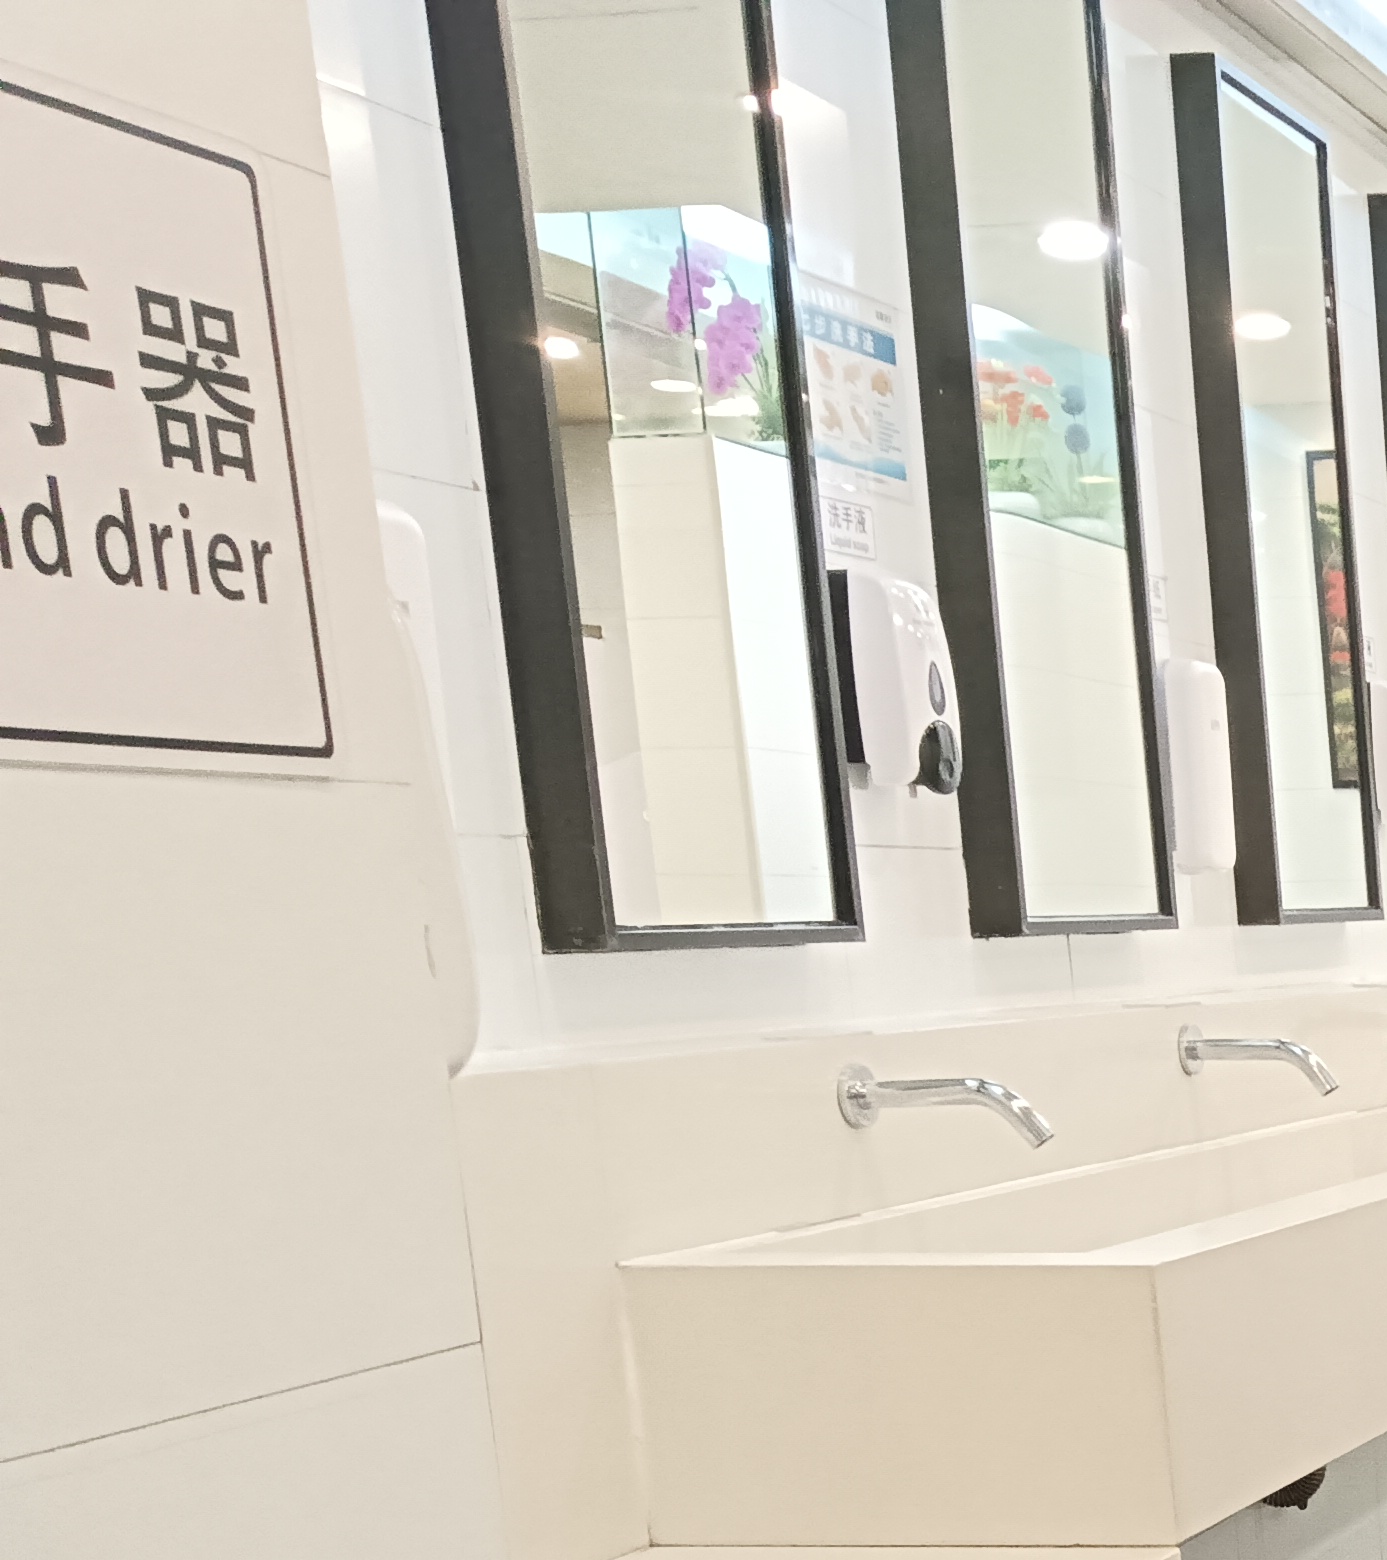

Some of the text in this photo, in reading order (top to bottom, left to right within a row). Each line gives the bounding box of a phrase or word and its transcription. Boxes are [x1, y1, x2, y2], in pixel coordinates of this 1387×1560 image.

[96, 487, 273, 604] drier
[827, 502, 868, 534] 洗手液
